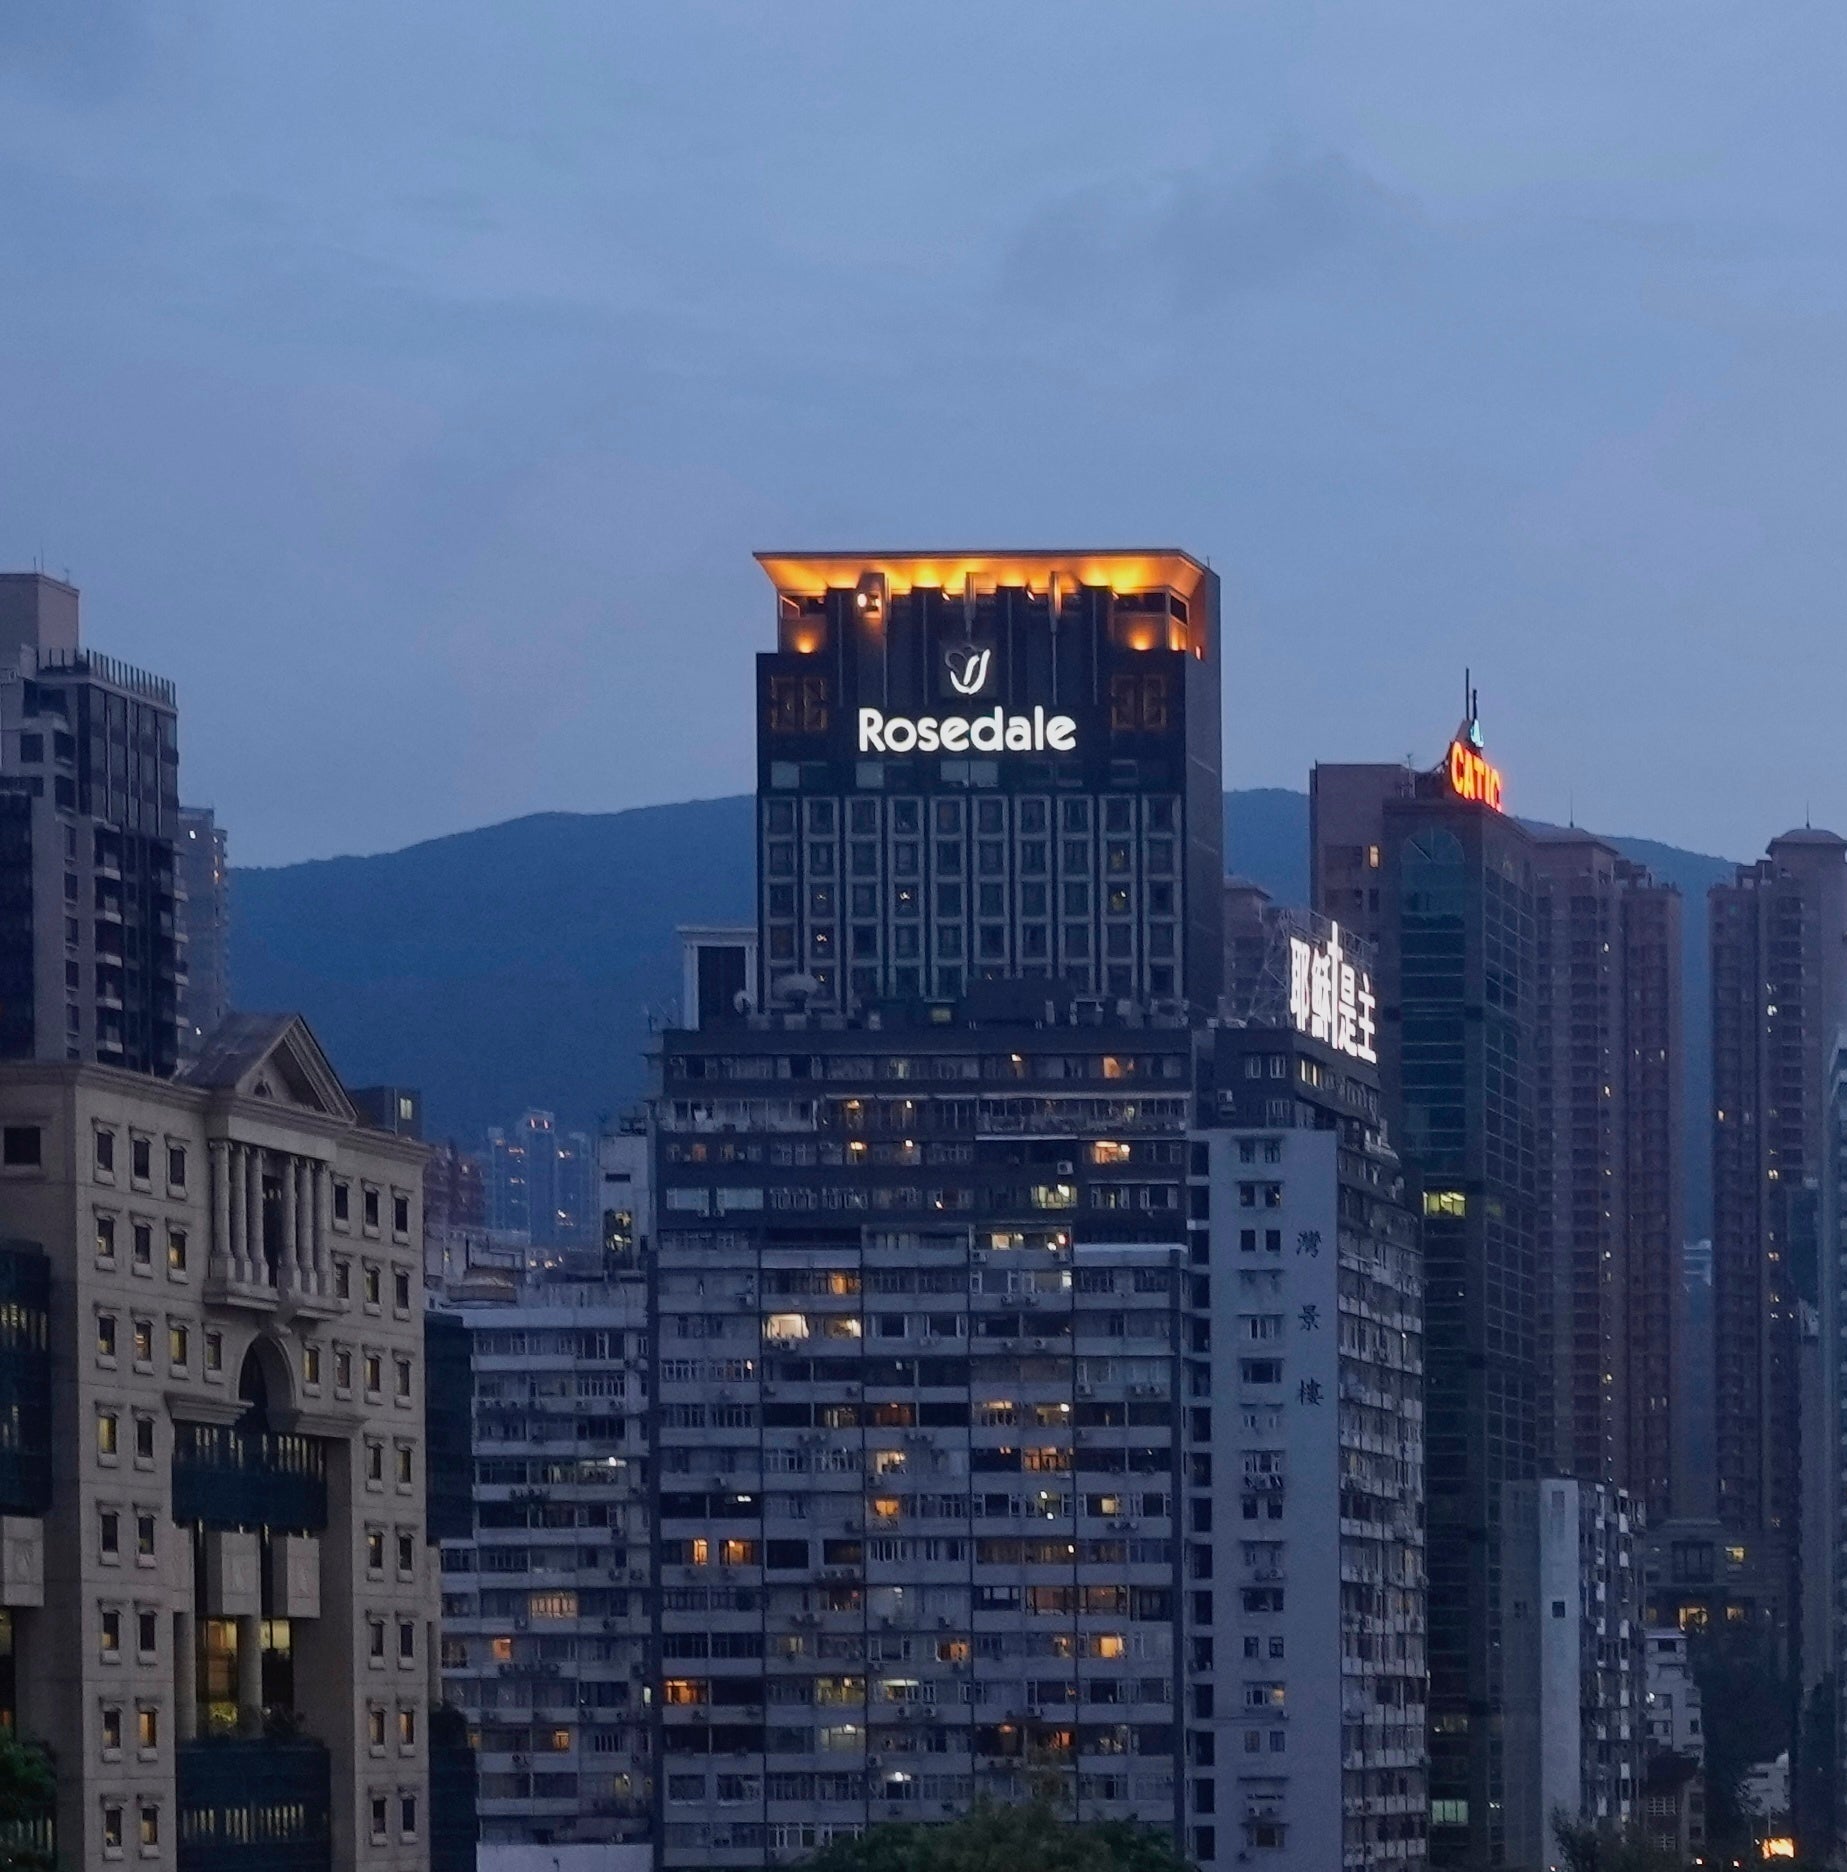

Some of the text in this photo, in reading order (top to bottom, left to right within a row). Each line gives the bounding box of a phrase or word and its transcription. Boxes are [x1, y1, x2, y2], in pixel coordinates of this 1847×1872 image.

[858, 705, 1077, 753] Rosedale
[1451, 741, 1503, 812] CATIC
[1289, 936, 1378, 1064] 耶穌是主
